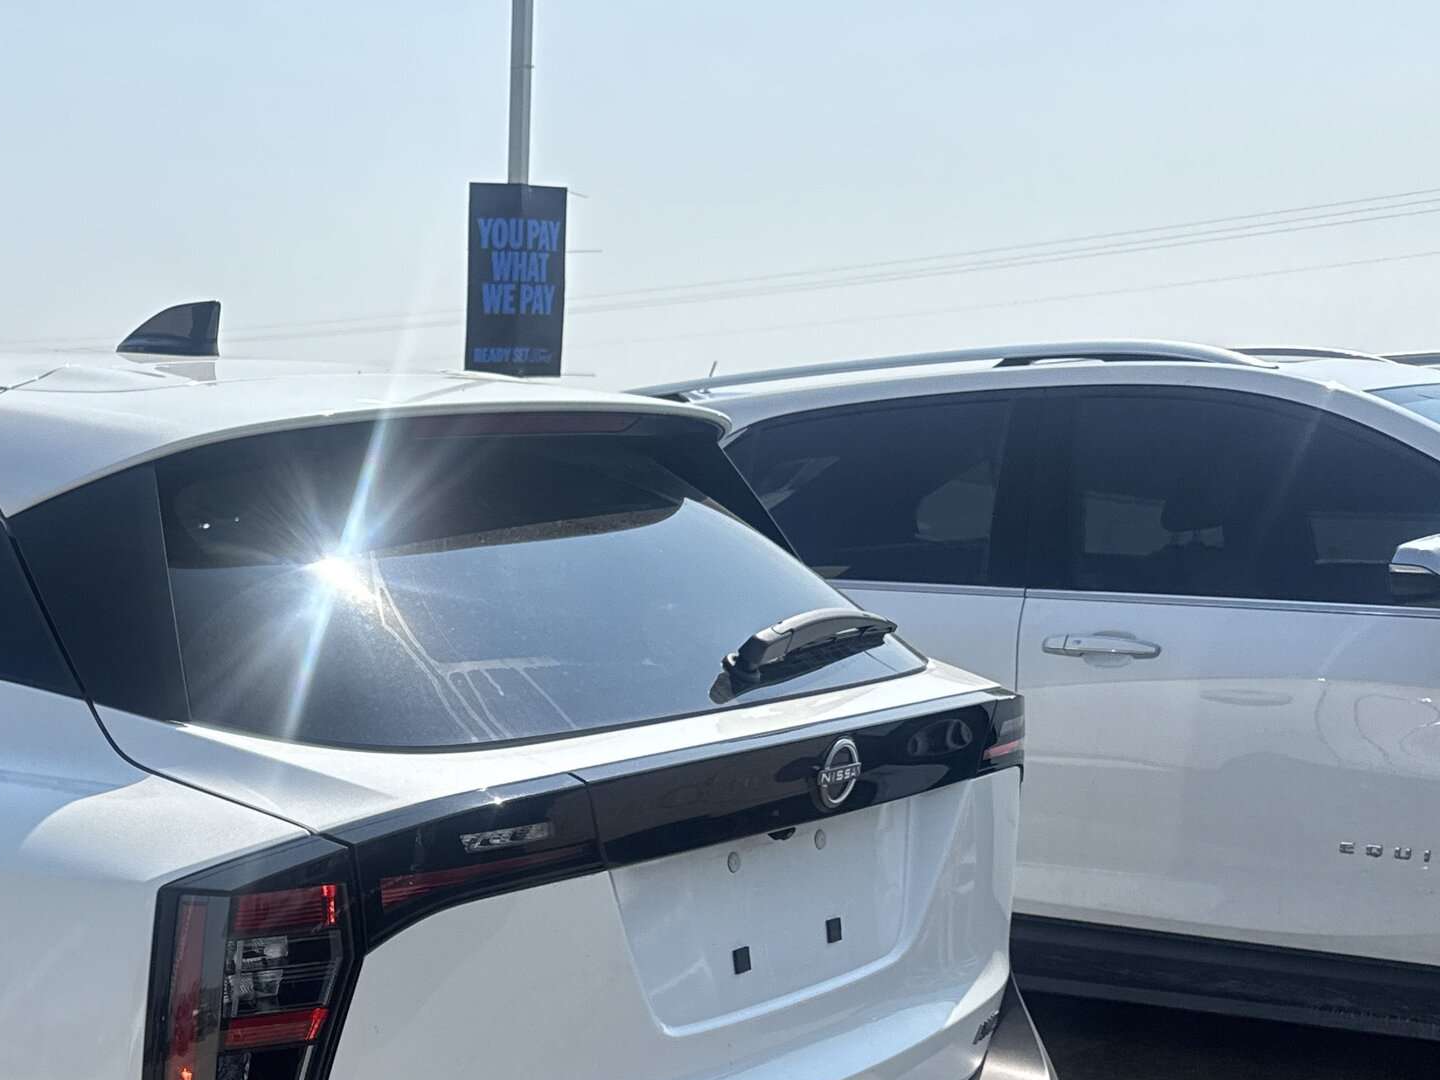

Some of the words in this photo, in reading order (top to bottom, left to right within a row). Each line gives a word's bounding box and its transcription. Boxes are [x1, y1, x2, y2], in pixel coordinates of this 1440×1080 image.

[477, 218, 523, 249] YOU
[527, 220, 560, 251] PAY
[491, 250, 549, 282] WHAT
[482, 283, 516, 315] WE
[520, 285, 555, 315] PAY
[473, 346, 511, 363] READY
